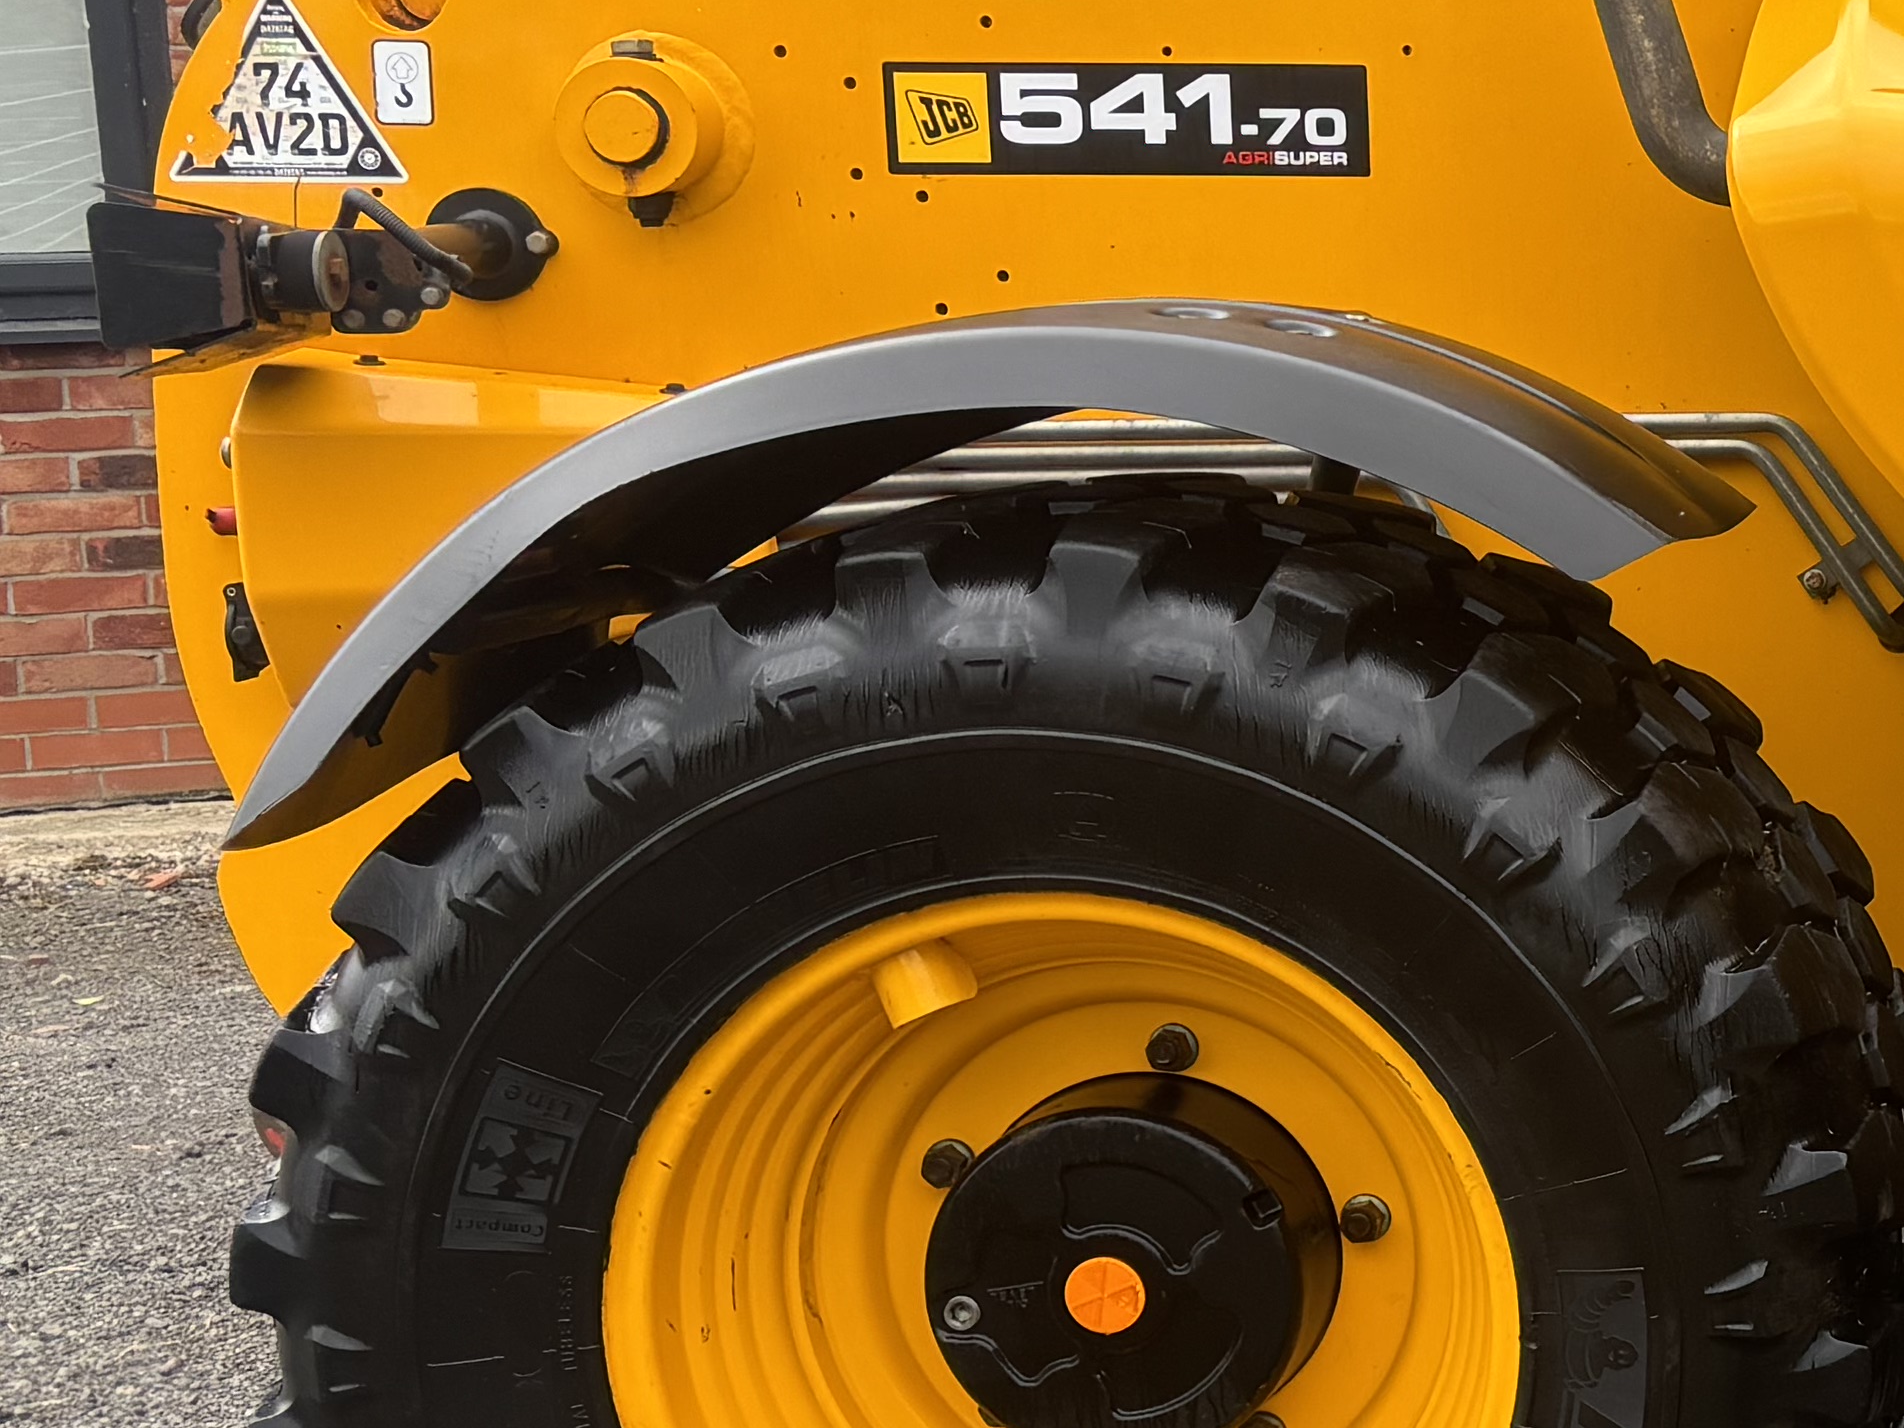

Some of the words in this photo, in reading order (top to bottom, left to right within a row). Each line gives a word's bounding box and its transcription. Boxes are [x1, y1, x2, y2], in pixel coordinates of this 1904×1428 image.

[252, 61, 312, 107] 74
[226, 110, 350, 157] AV2D
[916, 95, 974, 139] JCB
[1221, 150, 1349, 168] AGRISUPER
[503, 1083, 573, 1121] Line
[455, 1218, 544, 1238] Compact
